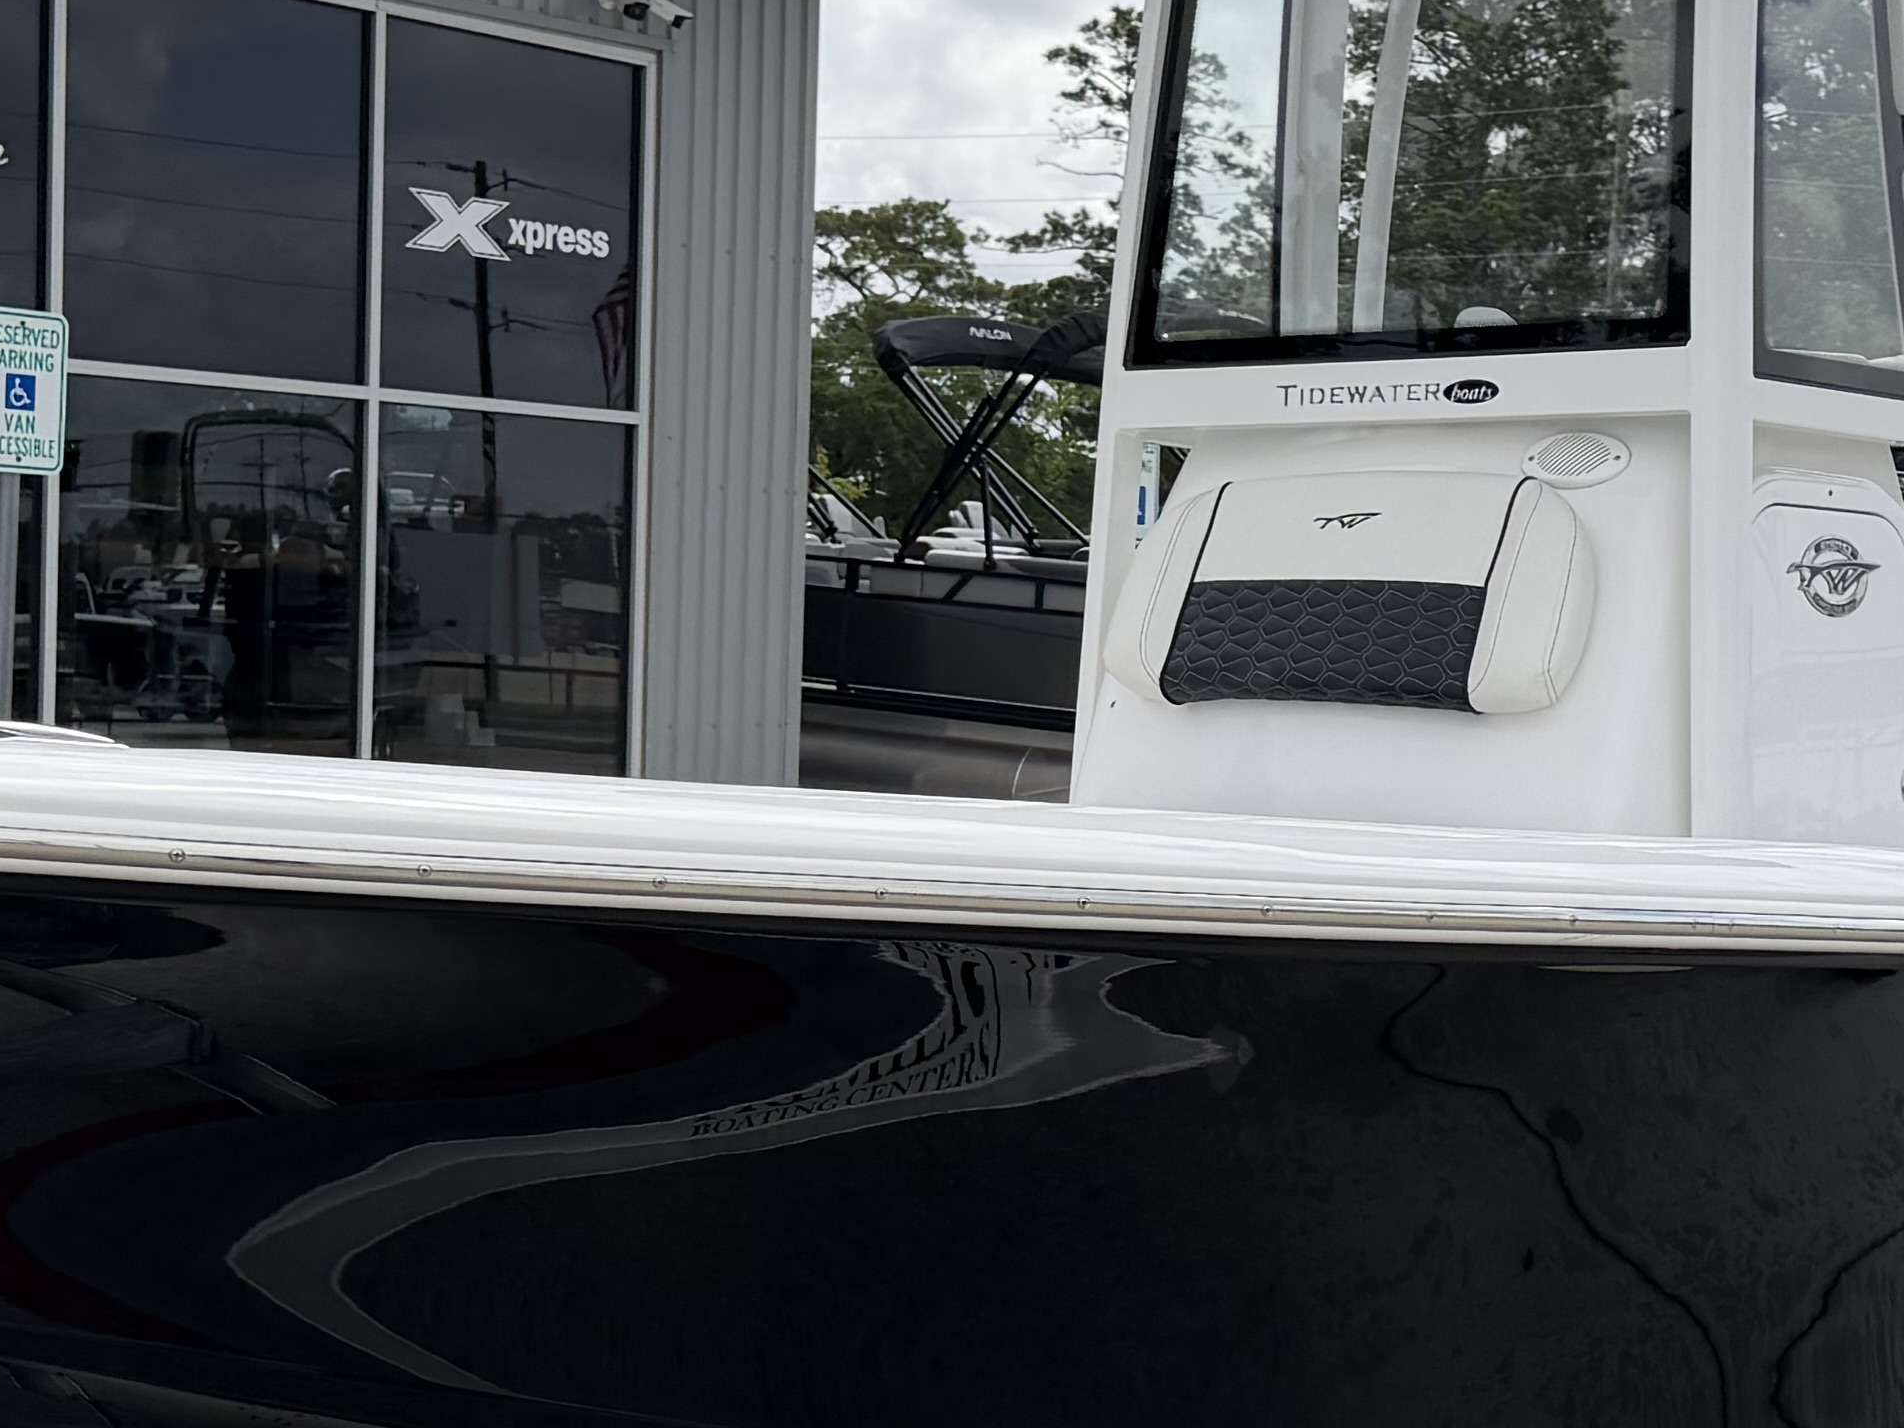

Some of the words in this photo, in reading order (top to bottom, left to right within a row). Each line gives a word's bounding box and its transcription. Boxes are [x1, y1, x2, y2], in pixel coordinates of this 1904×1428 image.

[507, 217, 610, 259] xpress
[1276, 382, 1440, 406] TIDEWATER
[1450, 384, 1494, 402] boats
[4, 413, 36, 434] VAN
